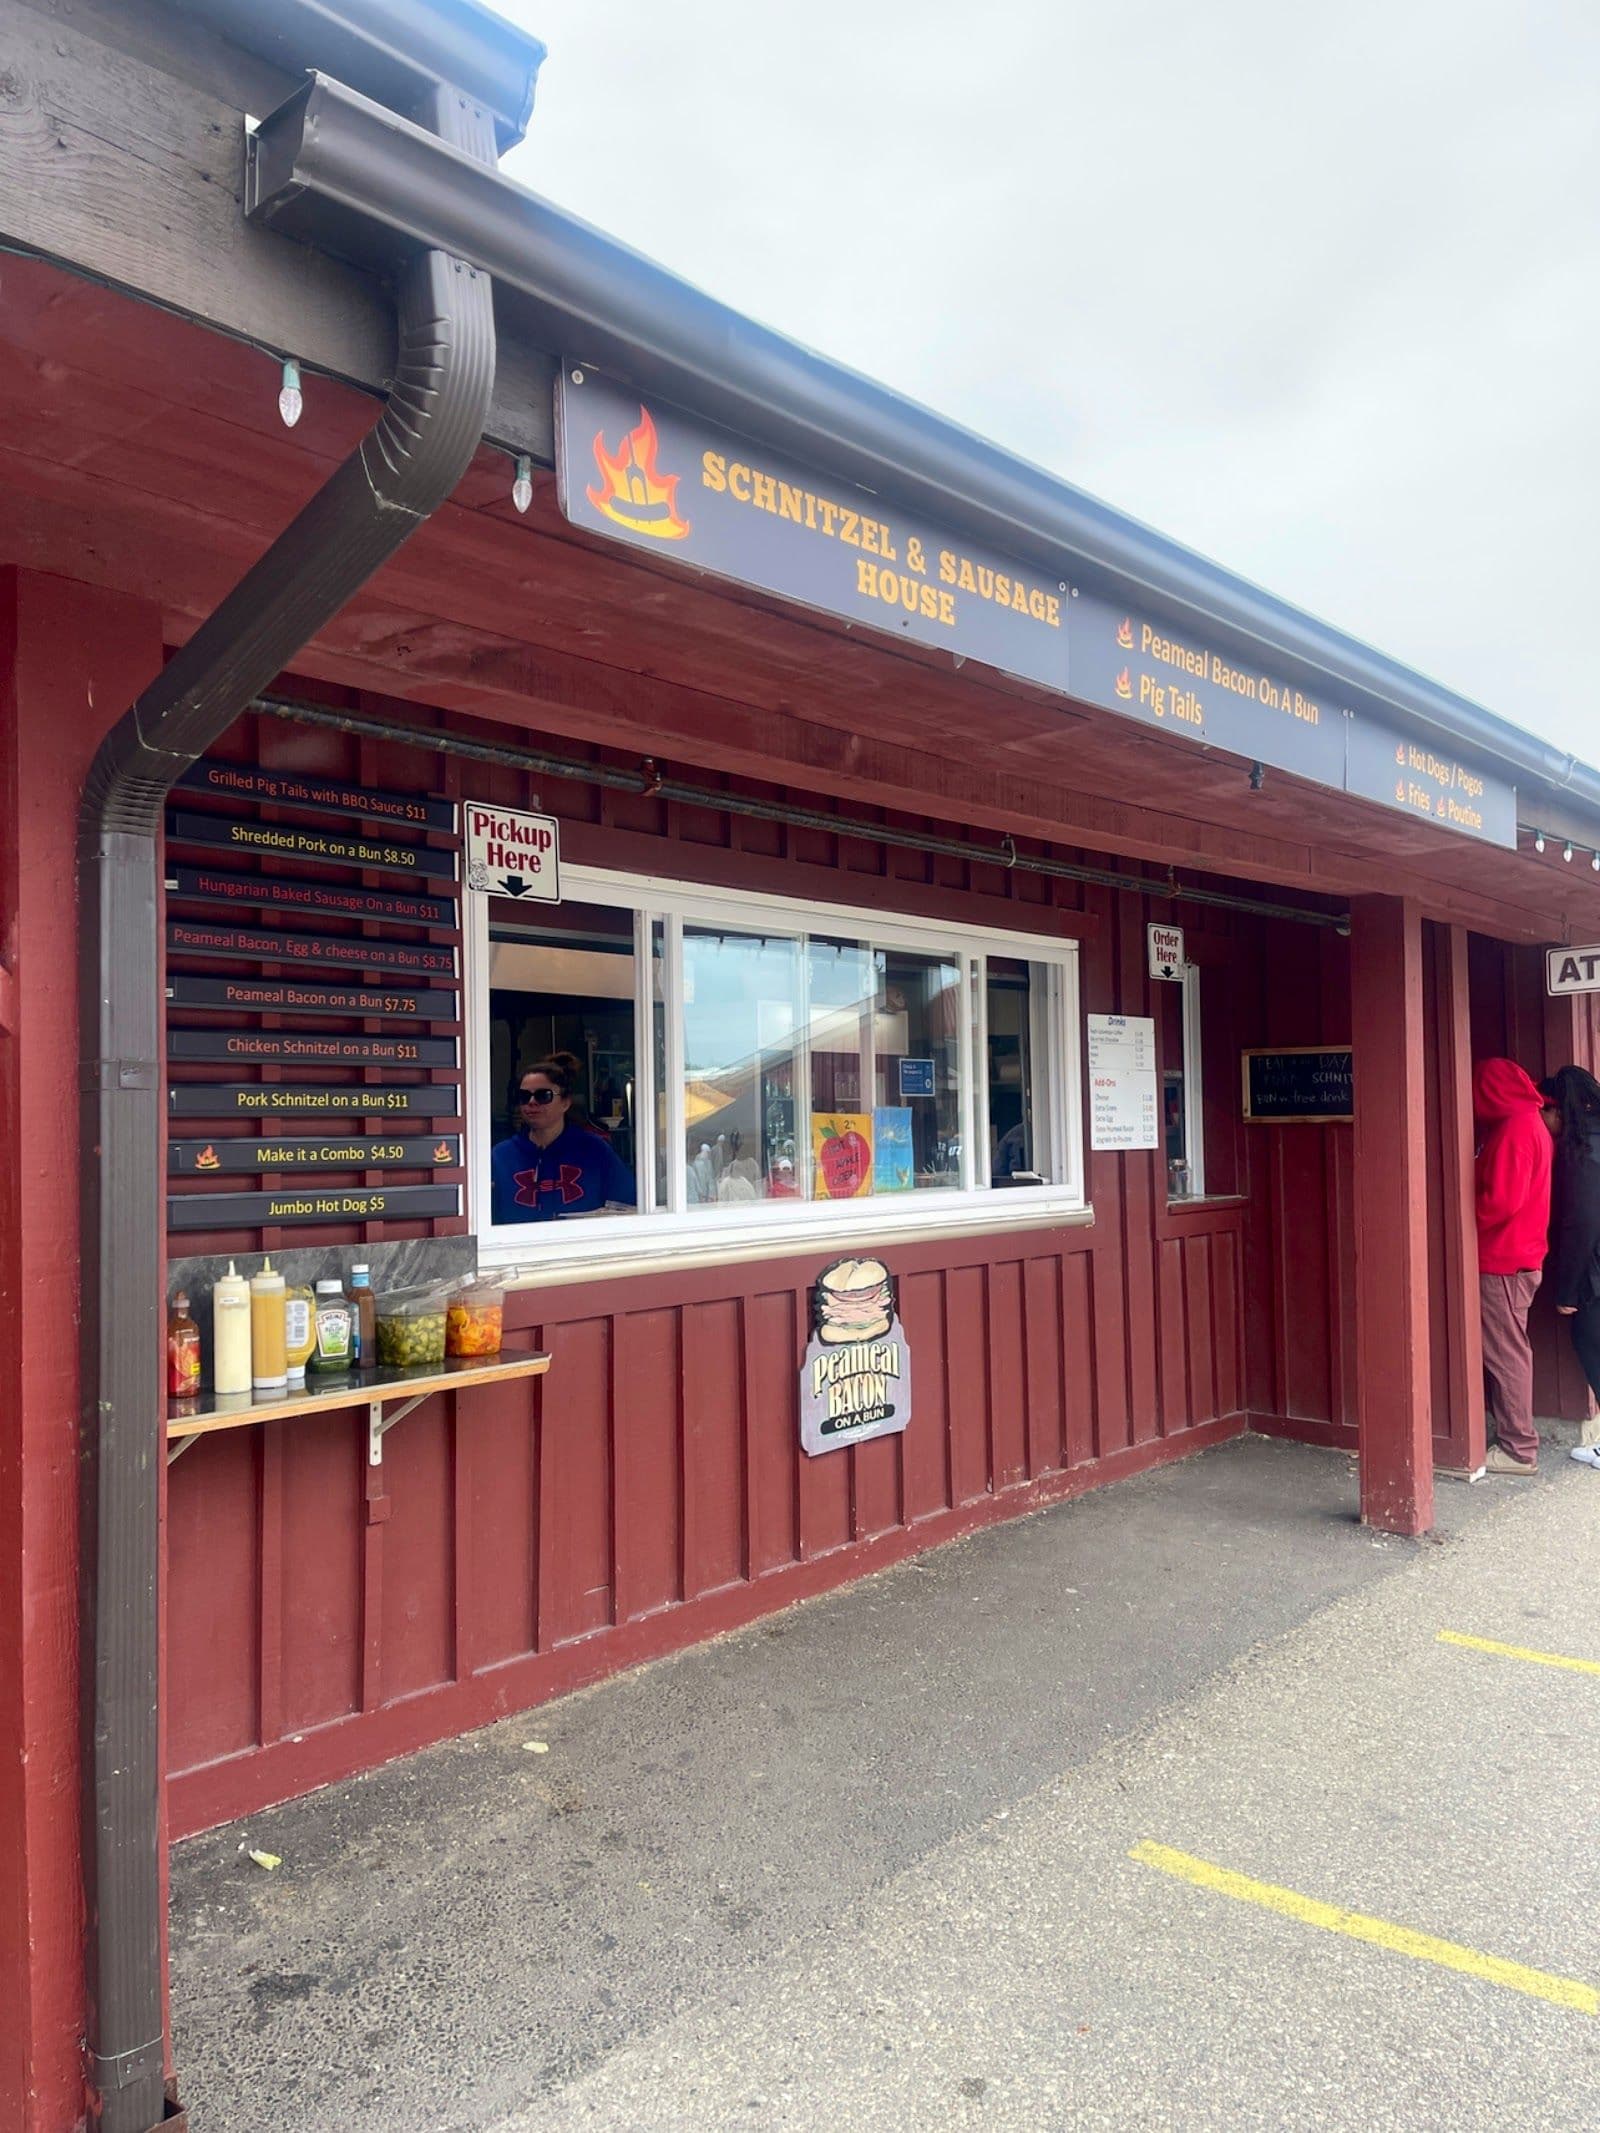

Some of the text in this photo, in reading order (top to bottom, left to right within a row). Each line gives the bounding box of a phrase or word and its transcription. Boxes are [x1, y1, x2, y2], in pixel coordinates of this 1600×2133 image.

[703, 451, 1060, 627] SCHNITZEL & SAUSAGE
[857, 559, 955, 626] HOUSE
[1142, 623, 1319, 726] Peameal Bacon On A Bun
[1140, 674, 1202, 725] Pig Tails
[1409, 745, 1483, 797] Hot Dogs / Pogos
[208, 769, 426, 820] Grilled Pig Tails with BBQ Sauce $11
[1409, 782, 1482, 829] Fries Poutine
[231, 827, 415, 867] Shredded Pork on a Bun $8.50
[473, 812, 552, 853] Pickup
[486, 841, 541, 873] Here
[199, 877, 439, 919] Hungarian Baked Sausage On a Bun $11
[174, 928, 452, 970] Peameal Bacon, Egg & cheese on a Bun $8.75
[1154, 930, 1179, 948] Order
[1156, 947, 1178, 963] Here
[227, 986, 416, 1013] Peameal Bacon on a Bun $7.75
[227, 1038, 417, 1059] Chicken Schnitzel on a Bun $11
[237, 1092, 408, 1109] Pork Schnitzel on a Bun $11
[257, 1146, 404, 1163] Make it a Combo $4.50
[268, 1197, 384, 1216] Jumbo Hot Dog $5
[828, 1373, 888, 1418] BACON
[834, 1407, 885, 1429] ON A BUN
